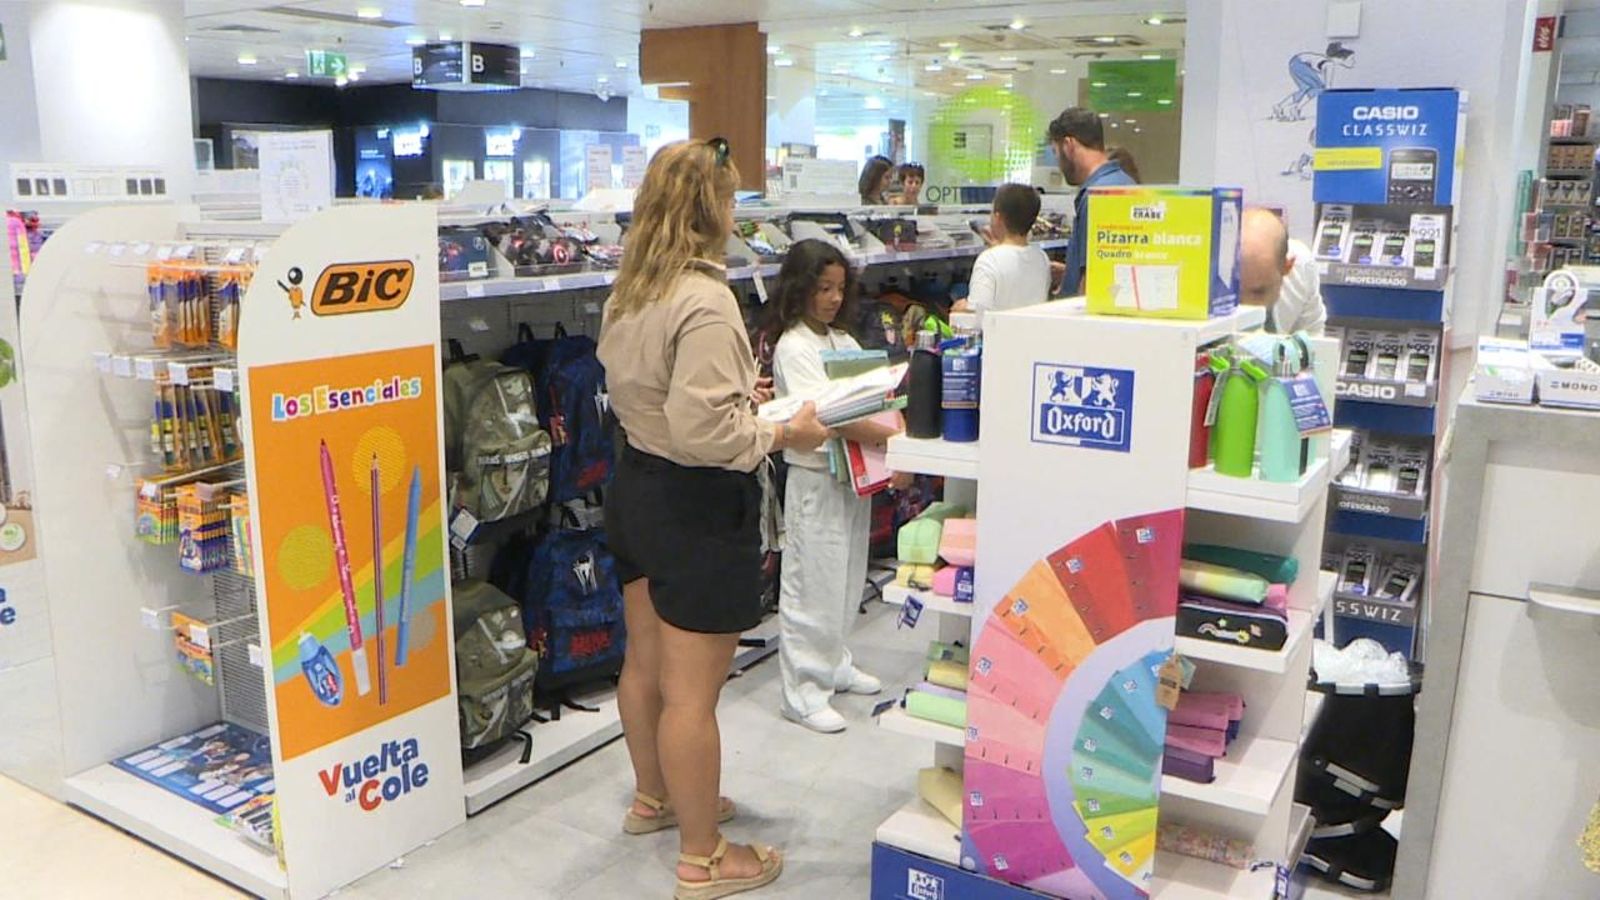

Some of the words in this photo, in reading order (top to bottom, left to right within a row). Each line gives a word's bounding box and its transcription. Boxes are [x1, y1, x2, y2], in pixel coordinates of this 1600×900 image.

[413, 57, 423, 75] B
[472, 54, 485, 73] B
[1352, 105, 1420, 121] CASIO
[1342, 123, 1428, 137] CLASSWIZ
[1096, 230, 1150, 245] Pizarra
[1096, 249, 1133, 260] Quadro
[1334, 382, 1396, 399] CASIO
[1561, 381, 1598, 391] MONO
[271, 392, 312, 421] Los
[313, 375, 422, 415] Esenciales
[1046, 405, 1115, 439] Oxford
[1335, 600, 1402, 621] SSWIZ
[318, 737, 419, 797] Vuelta
[344, 787, 356, 803] al
[358, 762, 429, 812] Cole
